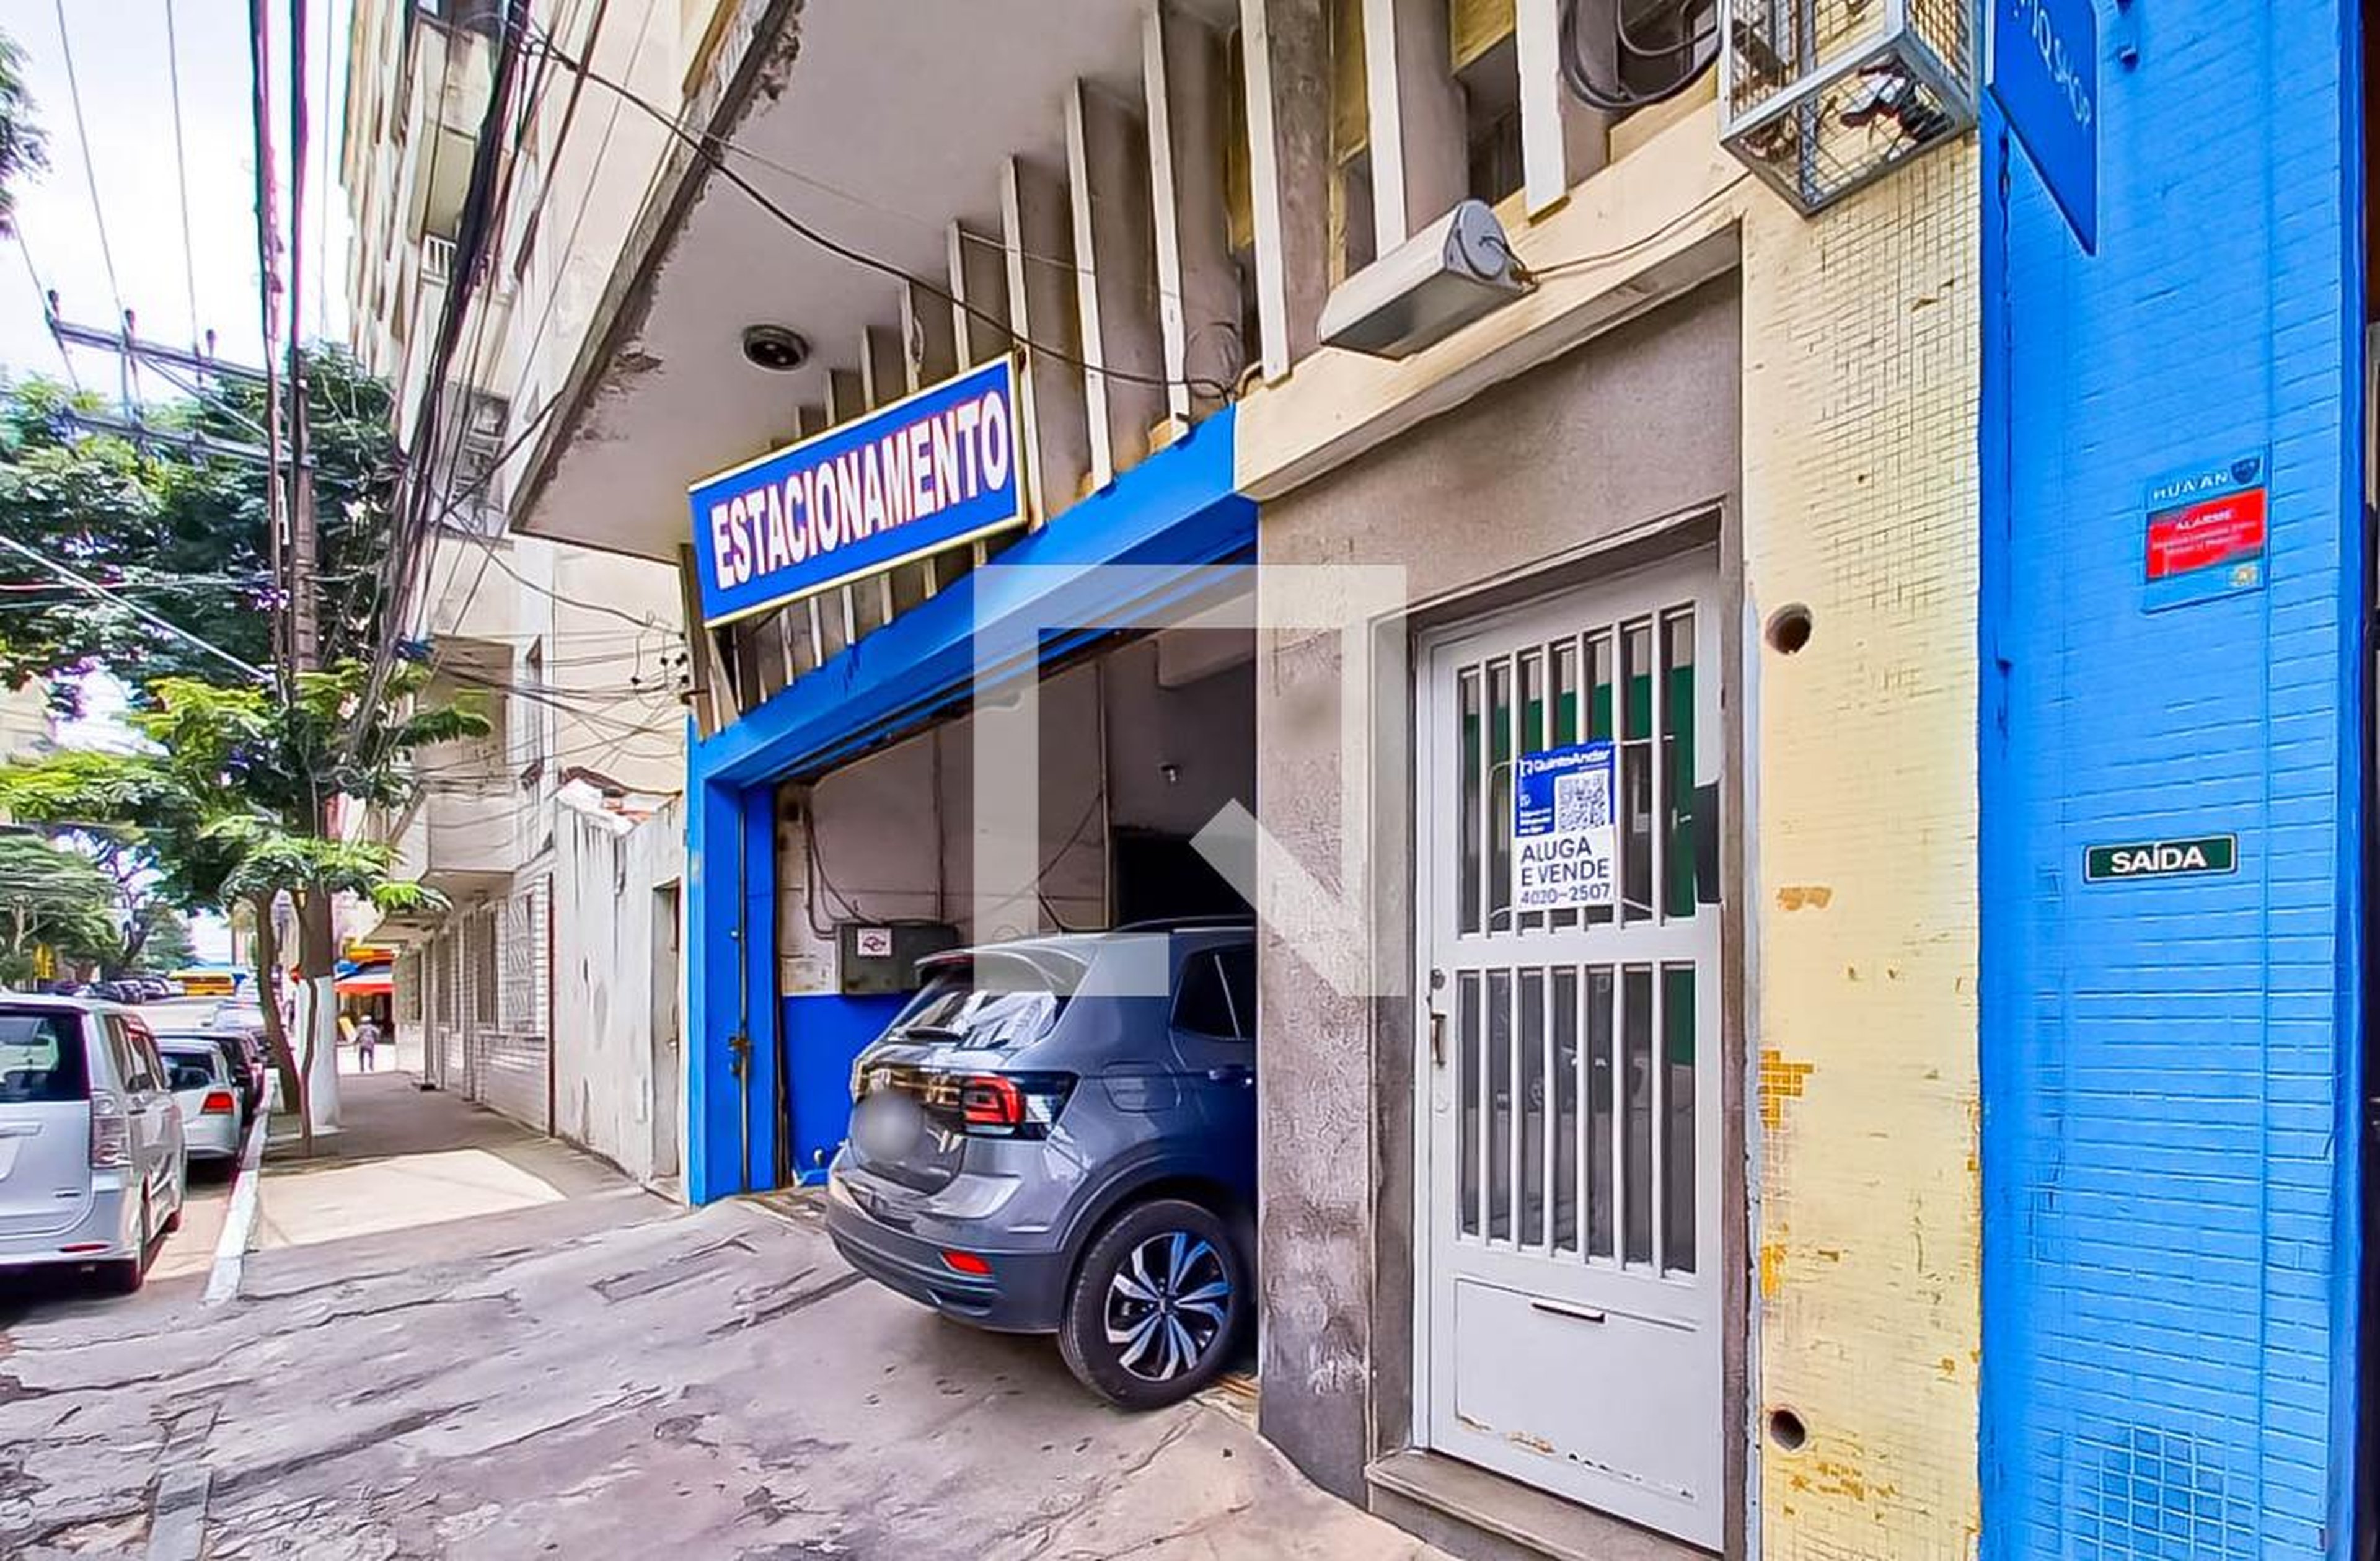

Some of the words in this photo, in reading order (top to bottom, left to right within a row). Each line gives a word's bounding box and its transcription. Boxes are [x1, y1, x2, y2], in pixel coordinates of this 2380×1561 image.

[711, 389, 1010, 591] ESTACIONAMENTO
[1521, 836, 1593, 864] ALUGA
[2111, 842, 2208, 873] SAÍDA
[1522, 867, 1533, 887] E
[1537, 858, 1610, 883] VENDE
[1520, 882, 1611, 905] 4020-2507
